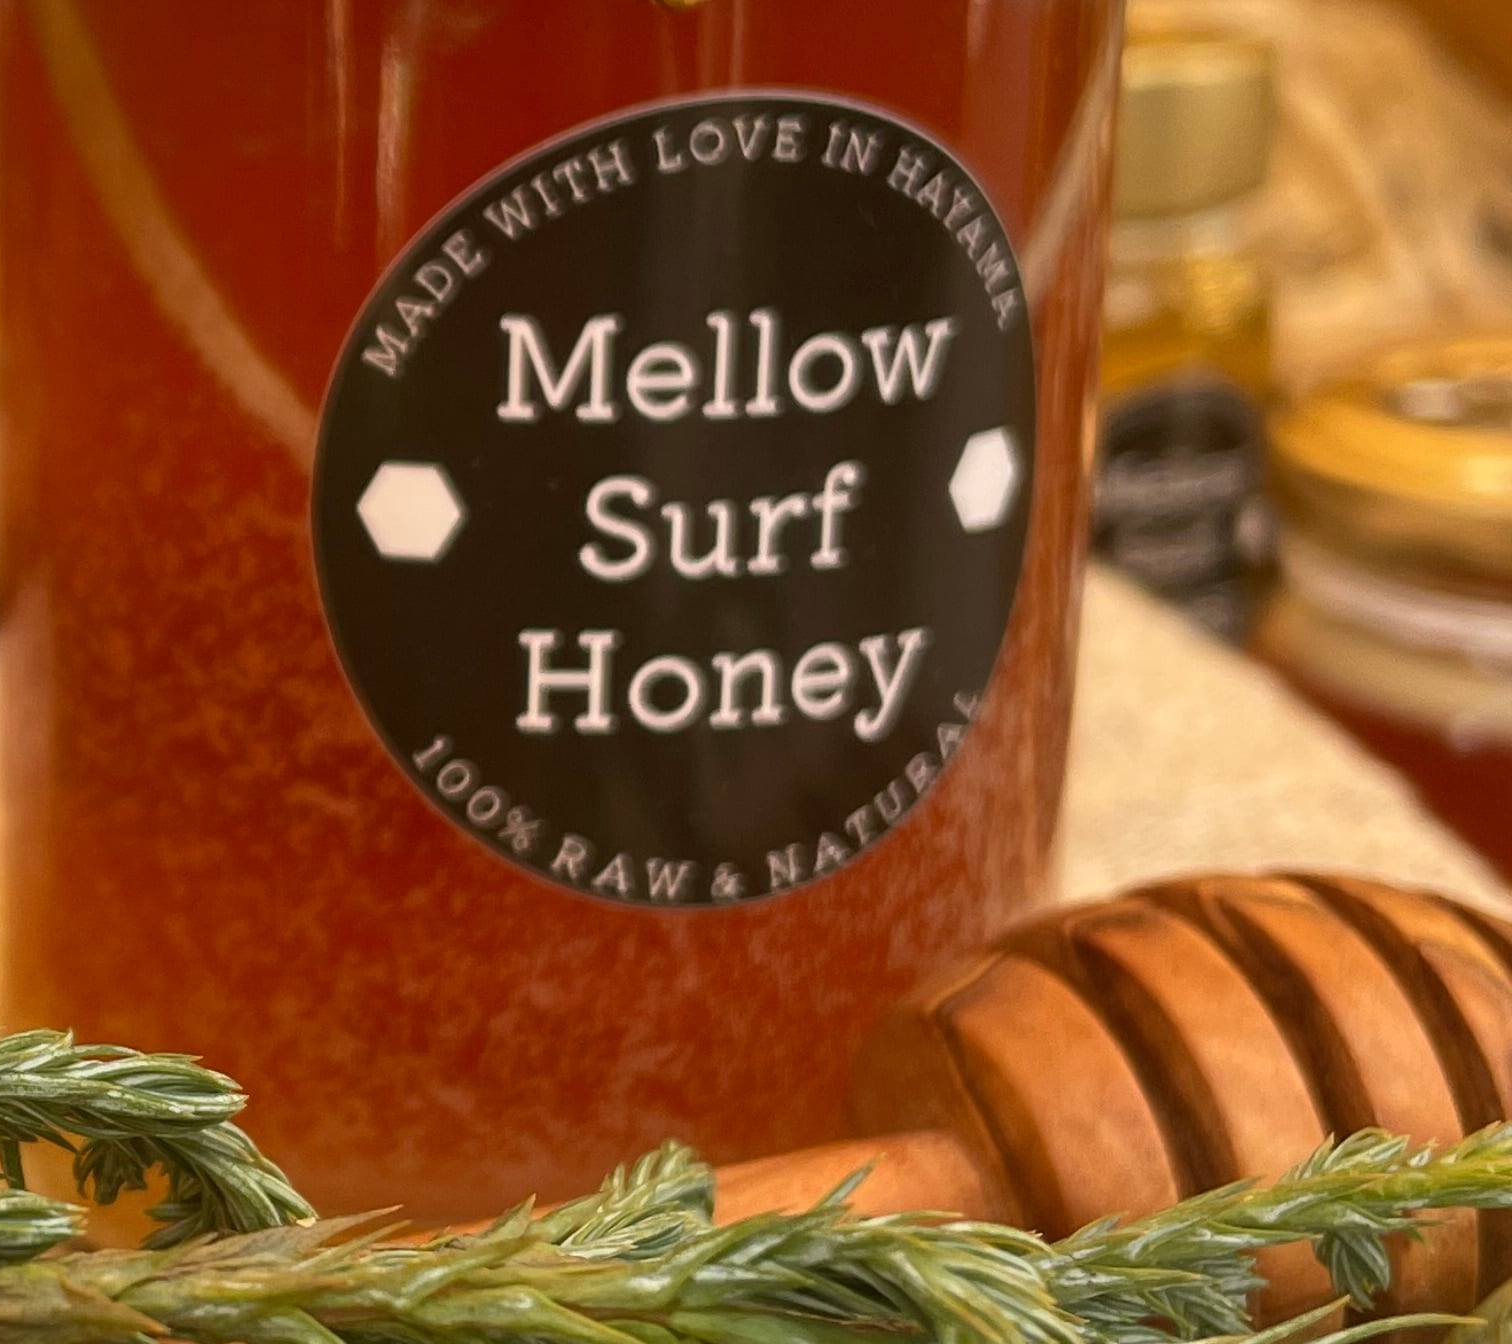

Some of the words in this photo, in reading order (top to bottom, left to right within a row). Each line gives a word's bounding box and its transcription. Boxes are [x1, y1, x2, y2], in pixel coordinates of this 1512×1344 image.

[361, 229, 488, 378] MADE
[484, 140, 635, 243] WITH
[652, 115, 804, 173] LOVE
[823, 120, 879, 174] IN
[887, 144, 1022, 331] HAYAMA
[496, 307, 956, 424] Mellow
[579, 461, 863, 582] Surf
[516, 627, 930, 741] Honey
[412, 735, 543, 855] 100%
[551, 835, 699, 901] RAW
[711, 861, 748, 900] &
[766, 687, 984, 893] NATURAL
